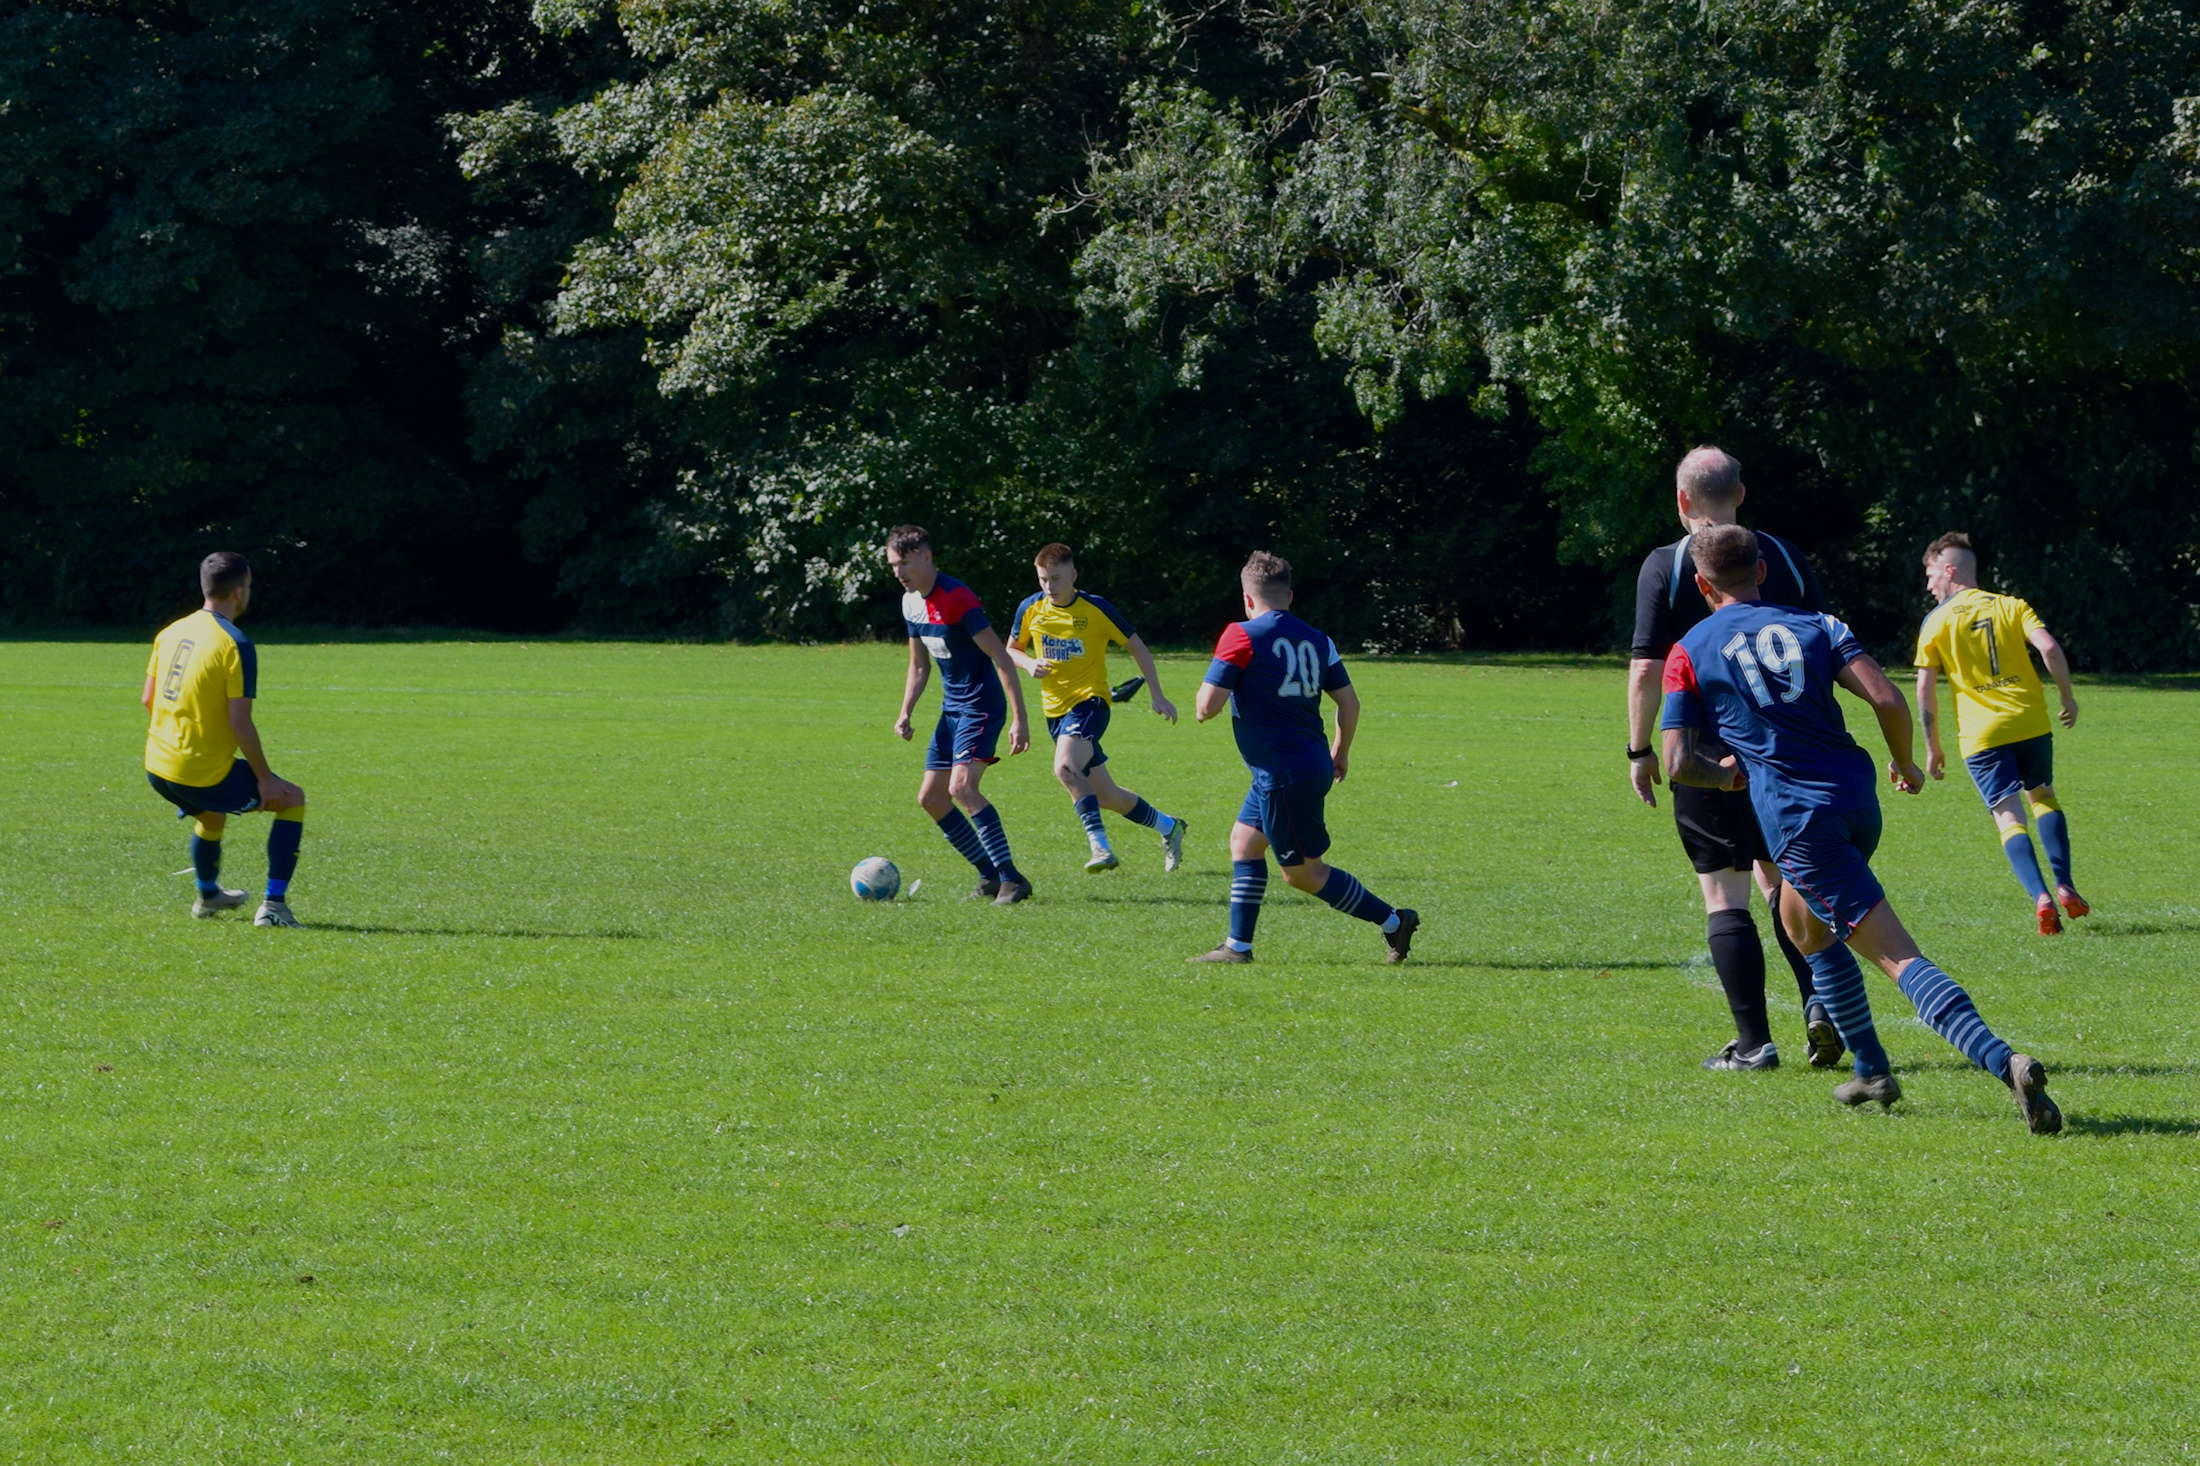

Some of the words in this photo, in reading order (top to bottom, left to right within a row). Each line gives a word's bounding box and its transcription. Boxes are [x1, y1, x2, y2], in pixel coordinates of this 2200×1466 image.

[163, 639, 195, 701] 8
[1042, 635, 1067, 647] Kara
[1043, 647, 1070, 660] LEISURE
[1271, 637, 1320, 698] 20
[1721, 624, 1805, 708] 19
[1971, 617, 2000, 676] 7
